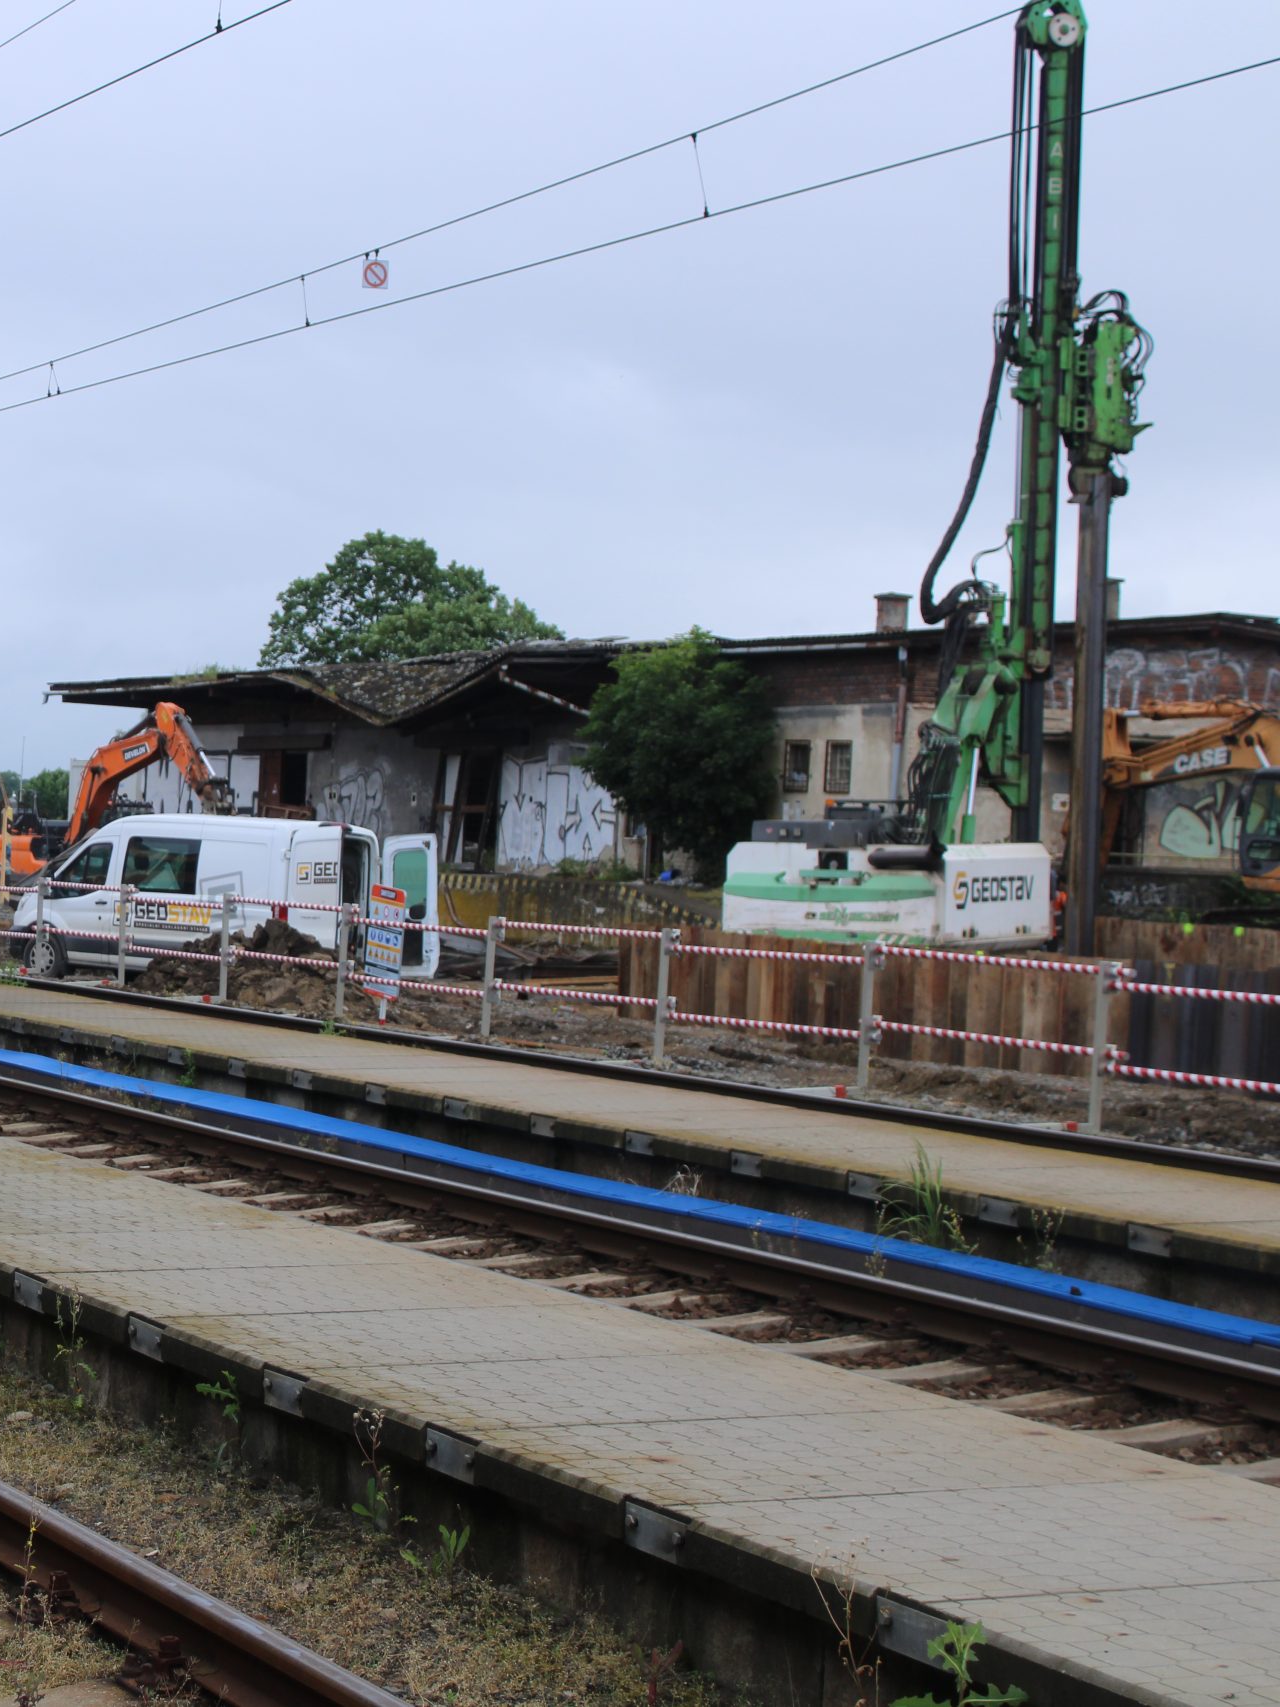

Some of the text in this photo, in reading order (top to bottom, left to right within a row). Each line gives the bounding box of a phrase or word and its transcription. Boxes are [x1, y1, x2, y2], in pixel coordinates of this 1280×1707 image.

[1048, 141, 1064, 231] ABI
[1174, 746, 1228, 773] CASE
[135, 902, 212, 925] GEOSTAV
